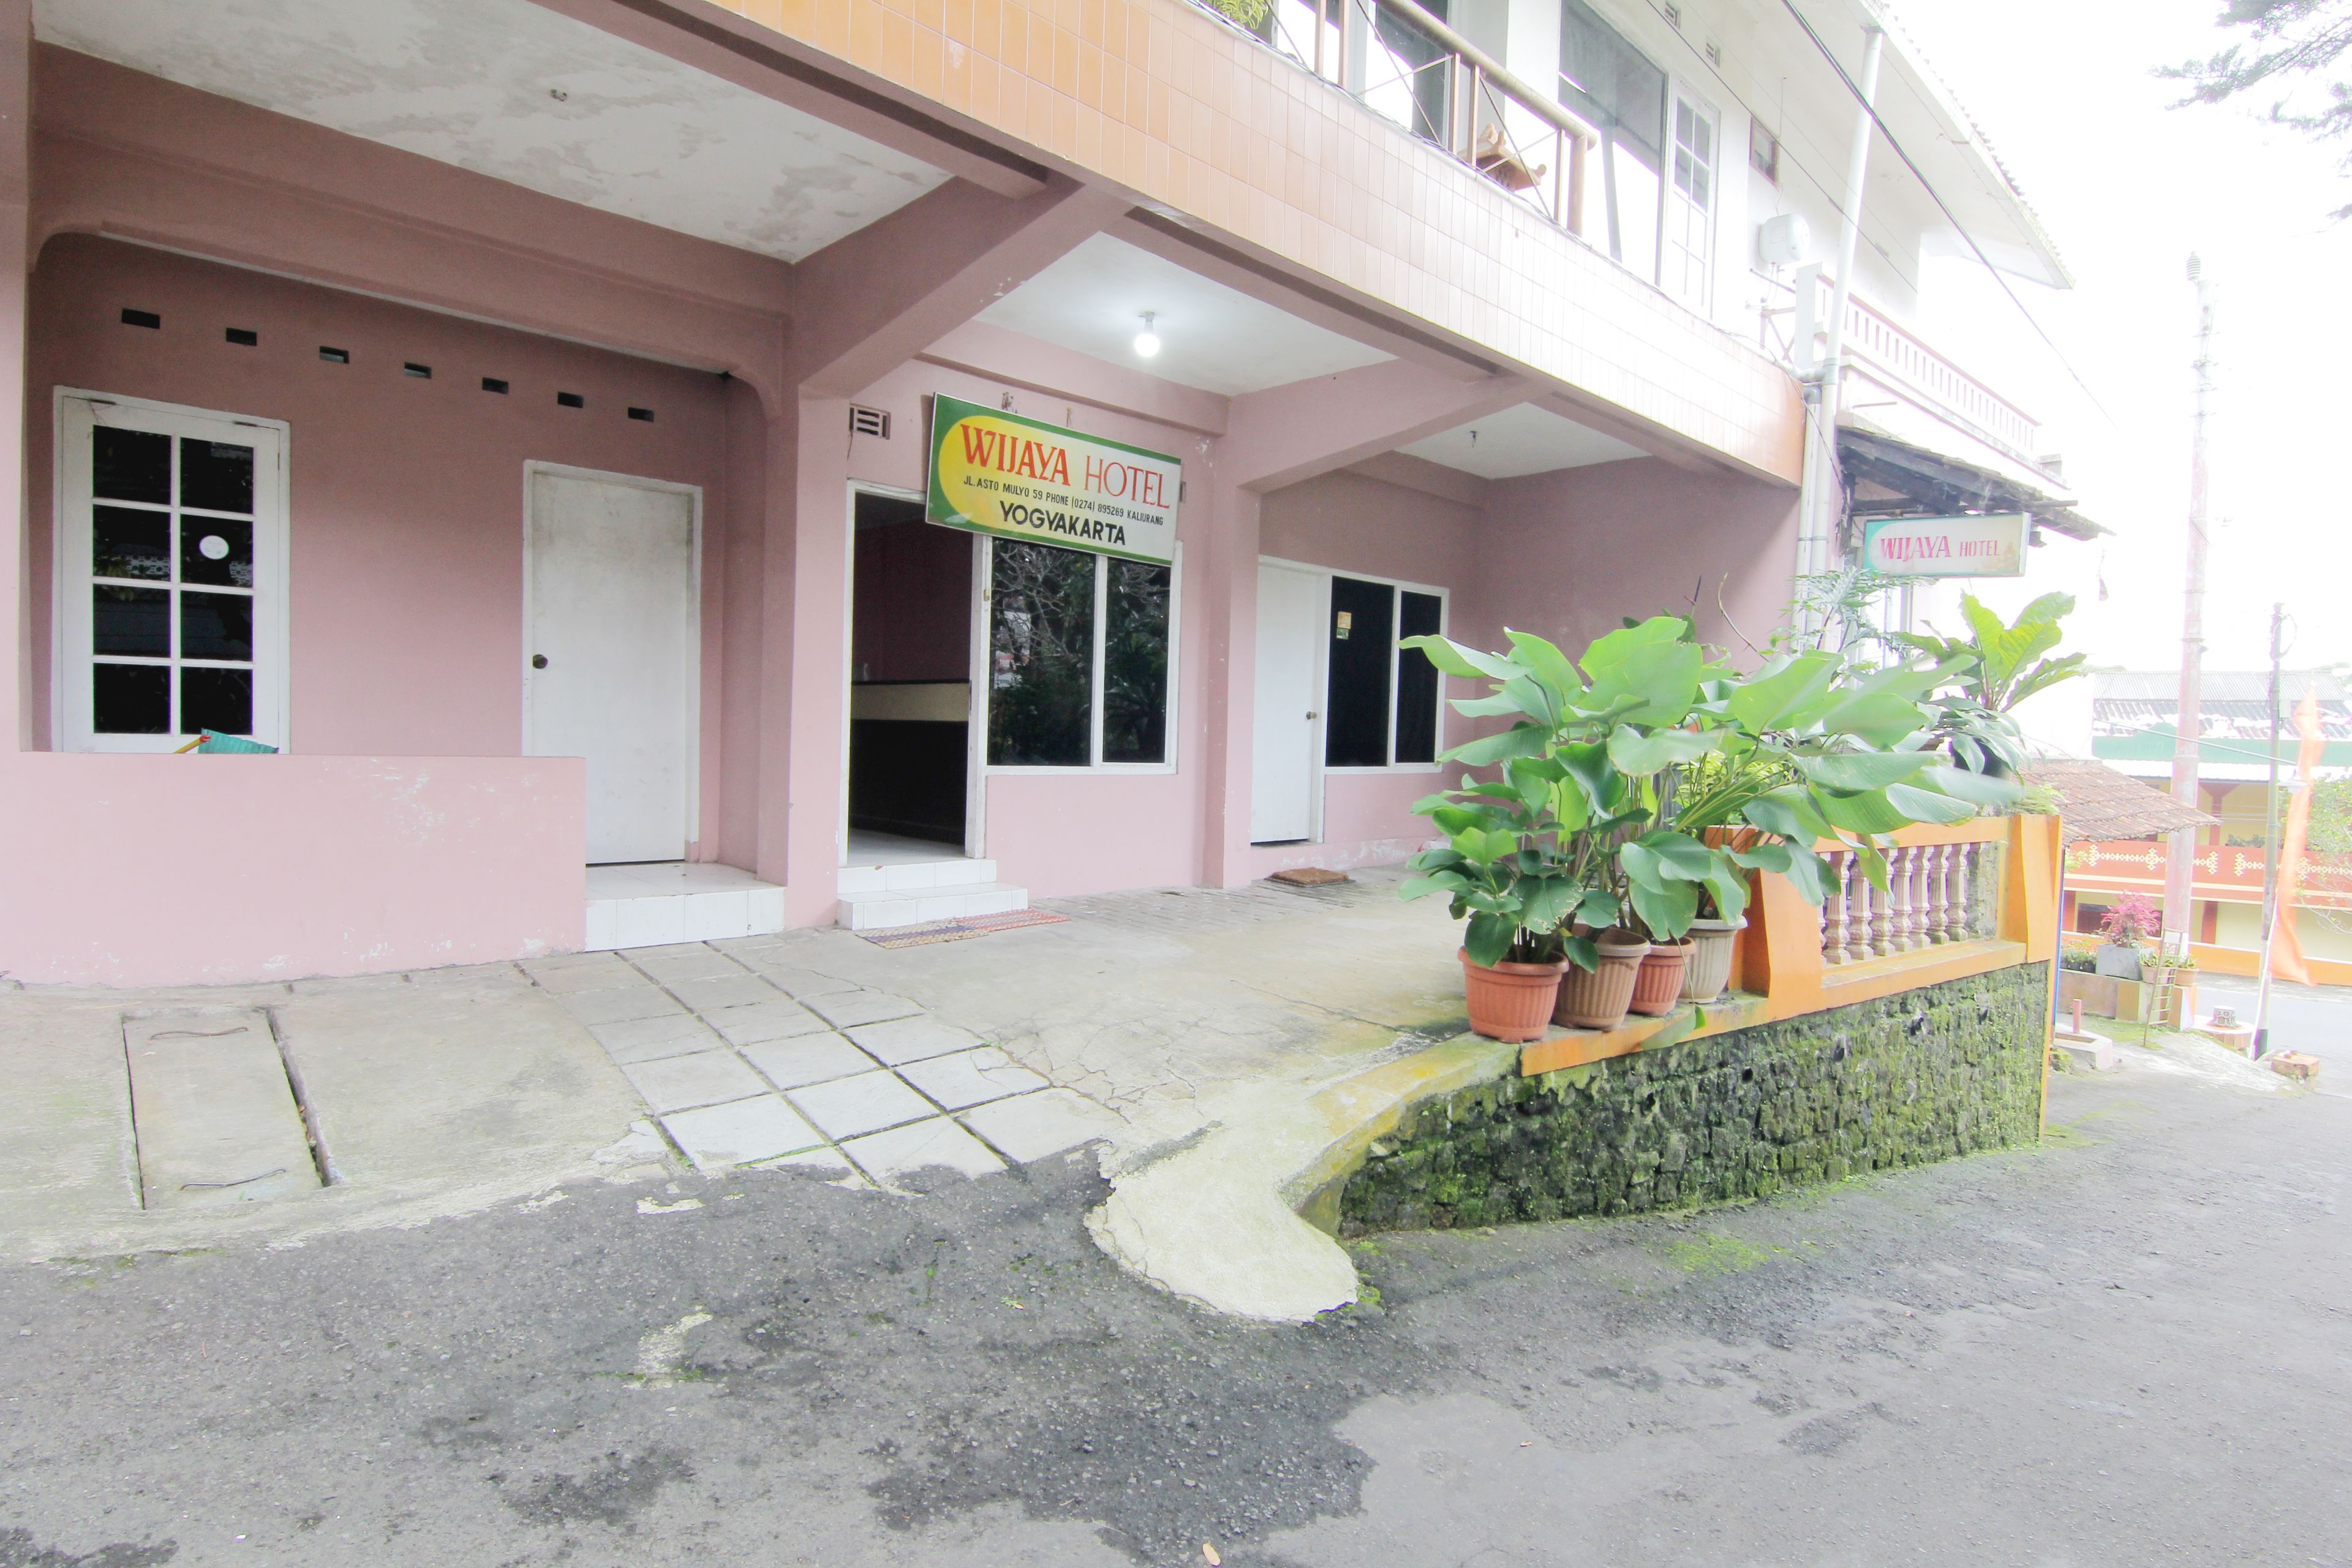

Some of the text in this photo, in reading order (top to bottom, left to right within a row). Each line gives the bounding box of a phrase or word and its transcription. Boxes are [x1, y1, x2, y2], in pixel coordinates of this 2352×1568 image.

[960, 423, 1170, 509] WIJAYA HOTEL
[1000, 500, 1126, 546] YOGYAKARTA
[1003, 483, 1030, 497] MULYO
[1033, 489, 1042, 500] 59
[1046, 492, 1069, 506] PHONE
[1072, 496, 1095, 513] (0274)
[1098, 503, 1124, 518] 895269
[1127, 510, 1164, 526] KALIURANG
[1880, 536, 2000, 562] WIJAYA HOTEL
